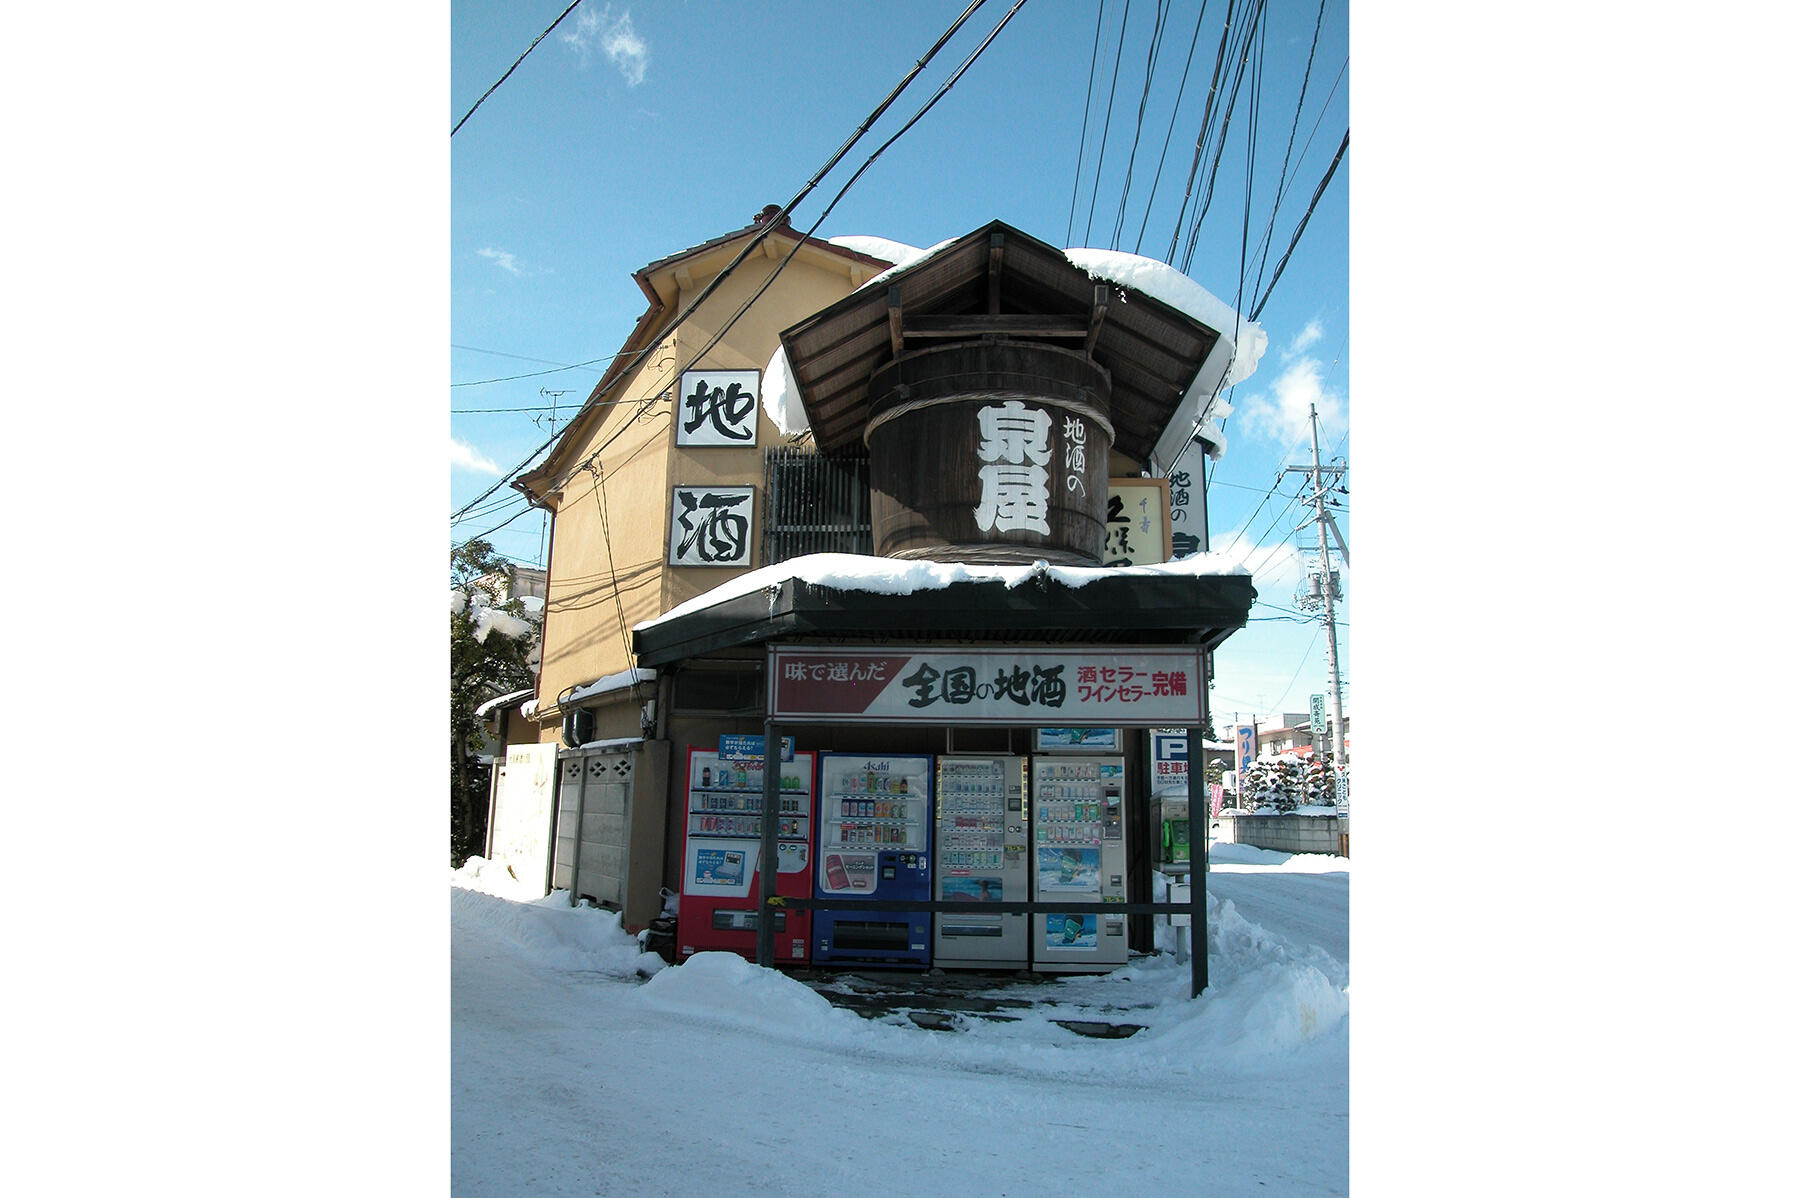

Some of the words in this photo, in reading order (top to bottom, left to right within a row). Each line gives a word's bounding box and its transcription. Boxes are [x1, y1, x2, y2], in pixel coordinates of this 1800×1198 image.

[683, 380, 754, 442] 地
[974, 400, 1053, 537] 泉屋
[1062, 415, 1086, 499] 地酒の
[1169, 471, 1192, 524] 地酒の
[677, 491, 749, 562] 酒
[784, 660, 887, 684] 味で選んだ
[902, 661, 1067, 709] 全国の地酒
[1077, 665, 1148, 684] 酒セラー
[1077, 684, 1152, 703] ワインセラー
[1151, 670, 1188, 698] 完備
[1161, 738, 1188, 759] P
